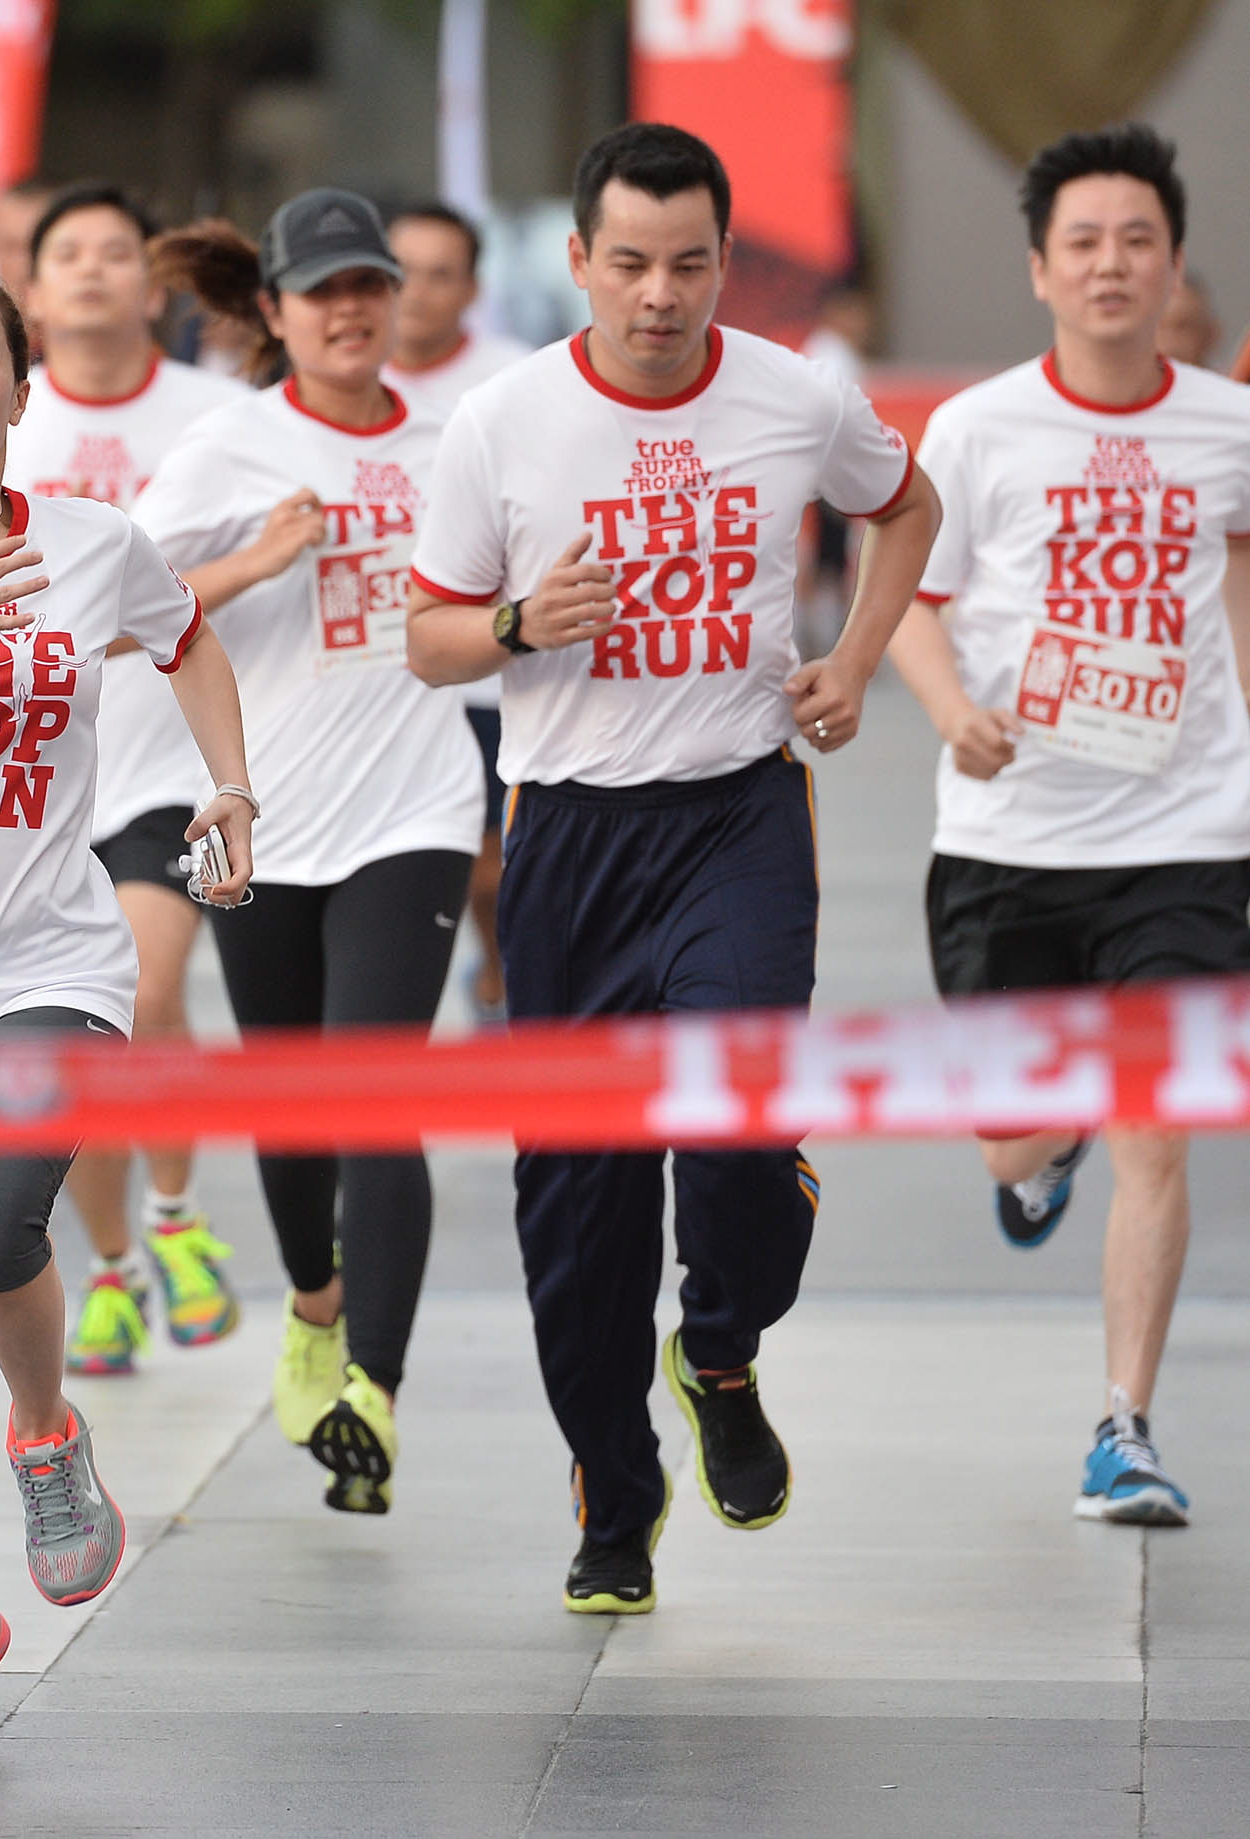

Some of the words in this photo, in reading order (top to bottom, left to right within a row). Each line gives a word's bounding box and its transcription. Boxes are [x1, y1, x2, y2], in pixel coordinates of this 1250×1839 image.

[631, 458, 702, 476] SUPER
[636, 438, 694, 458] true
[583, 486, 757, 561] THE
[1046, 485, 1197, 538] THE
[1046, 540, 1191, 592] KOP
[590, 613, 753, 680] RUN
[1045, 596, 1186, 647] RUN
[1073, 667, 1178, 721] 3010
[620, 988, 1114, 1138] THE
